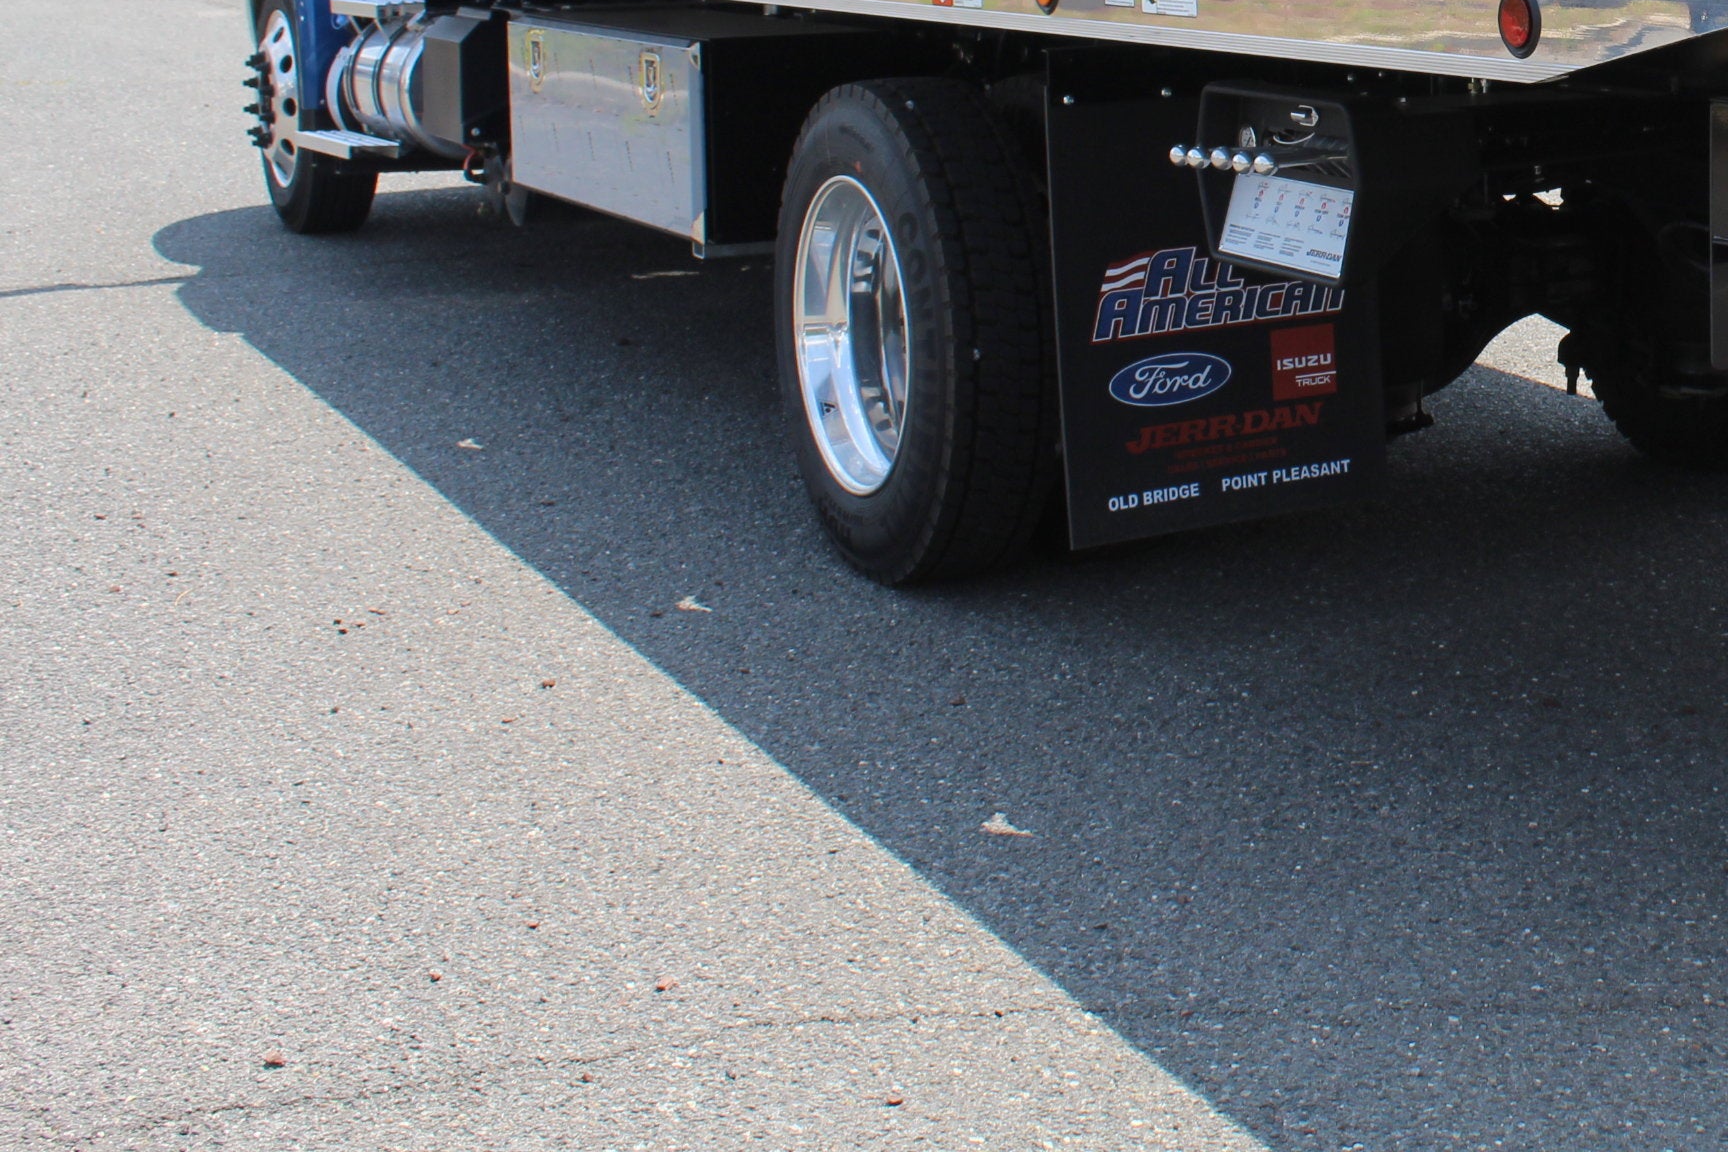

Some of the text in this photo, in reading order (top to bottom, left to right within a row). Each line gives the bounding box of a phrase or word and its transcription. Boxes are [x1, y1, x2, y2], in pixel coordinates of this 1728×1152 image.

[1145, 247, 1244, 298] ALL
[1093, 281, 1346, 342] AMERICAN
[1129, 361, 1212, 399] Ford
[1277, 353, 1332, 371] ISUZU
[1295, 375, 1331, 388] TRUCK
[1108, 494, 1139, 512] OLD
[1143, 483, 1200, 506] BRIDGE
[1222, 471, 1269, 492] POINT
[1273, 459, 1352, 484] PLEASANT
